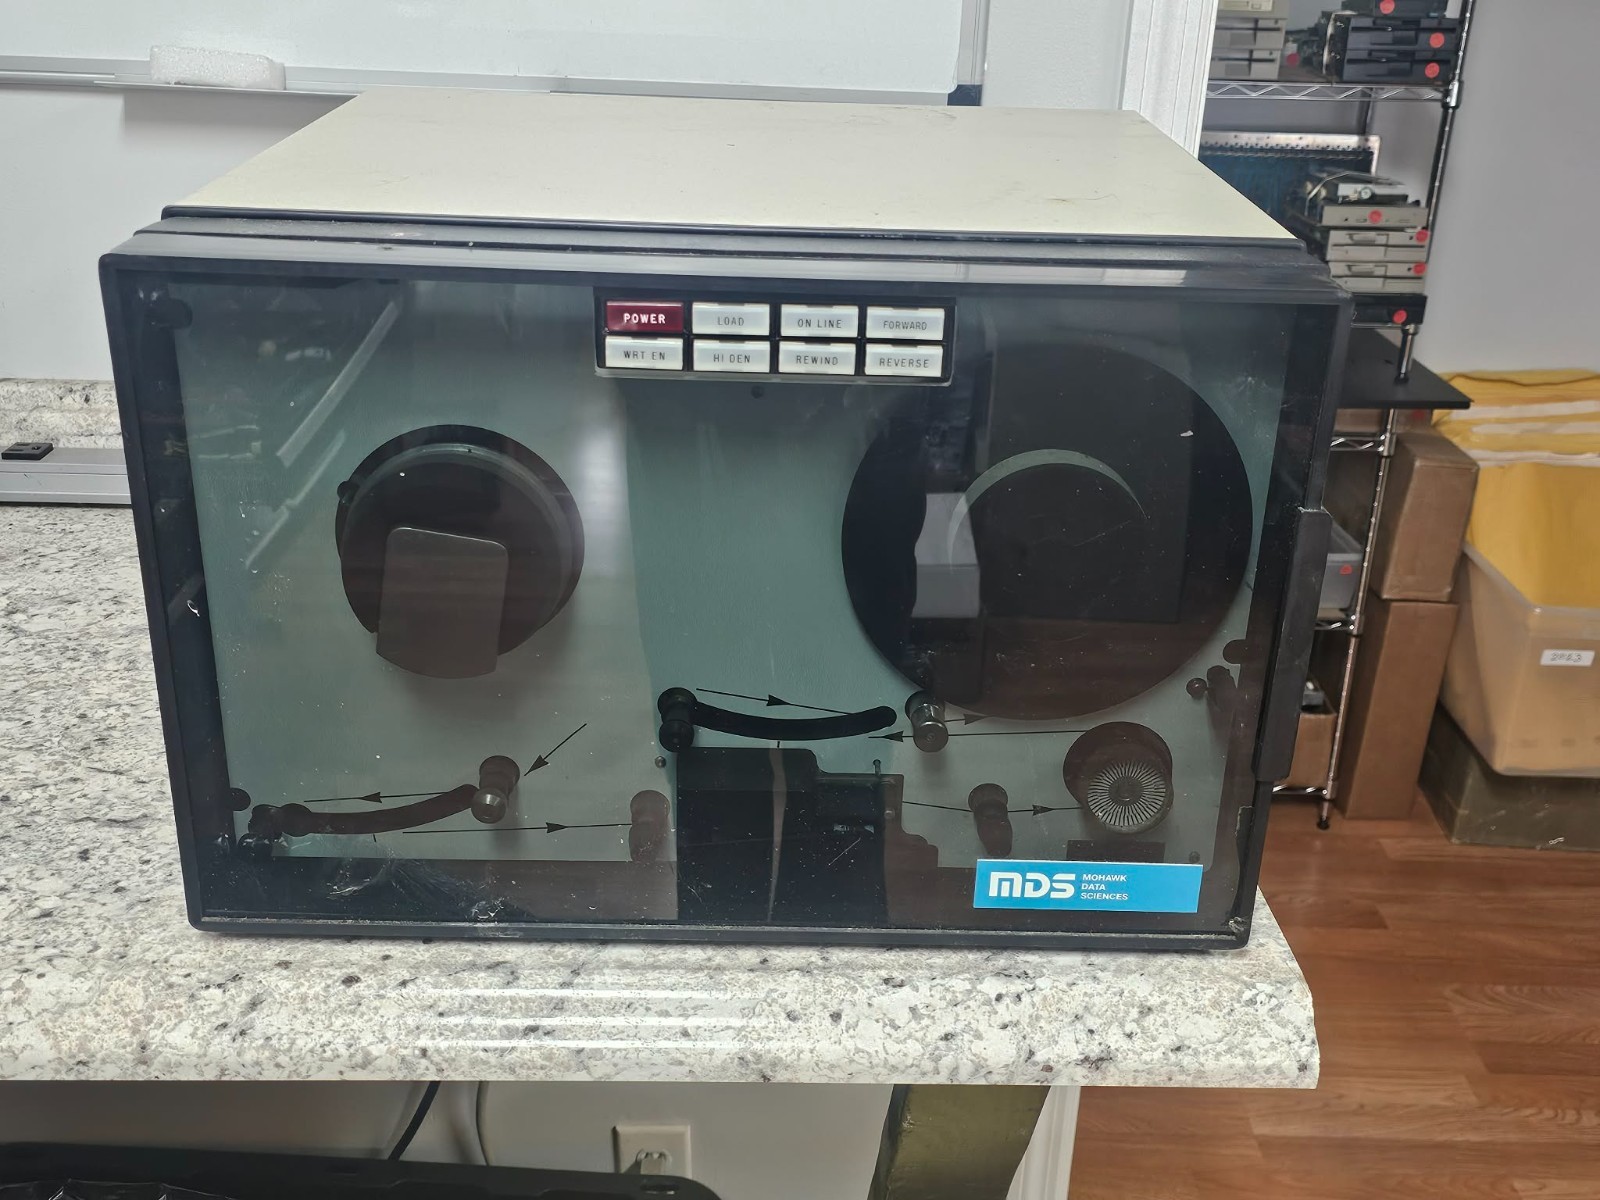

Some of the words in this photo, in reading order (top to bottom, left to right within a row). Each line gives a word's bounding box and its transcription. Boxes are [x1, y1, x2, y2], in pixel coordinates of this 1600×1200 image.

[623, 313, 666, 324] POWER
[717, 316, 745, 326] LOAD
[797, 318, 812, 329] ON
[817, 319, 842, 329] LINE
[883, 320, 928, 330] FORWARD
[623, 351, 647, 360] WRT
[652, 352, 666, 361] EN
[713, 355, 725, 364] HI
[729, 355, 751, 364] DEN
[796, 355, 839, 366] REWIND
[879, 358, 930, 369] REVERSE
[1082, 873, 1127, 882] MOHAWK
[988, 871, 1076, 898] MDS
[1081, 883, 1106, 891] DATA
[1080, 892, 1129, 901] SCIENCES
